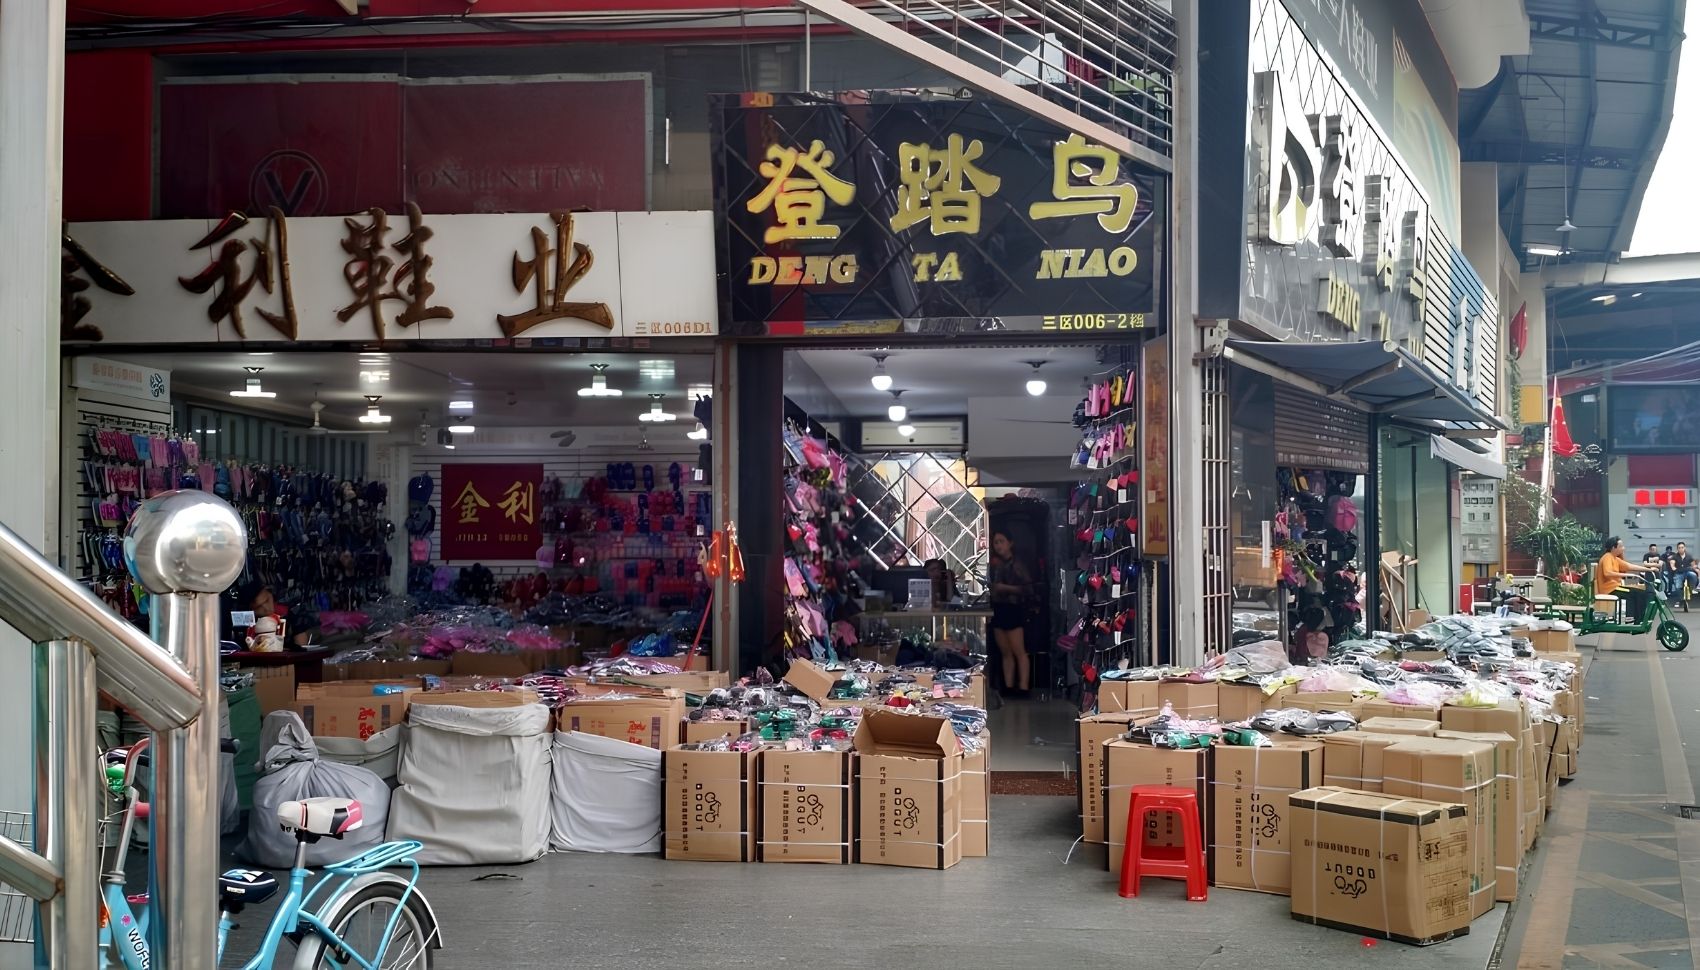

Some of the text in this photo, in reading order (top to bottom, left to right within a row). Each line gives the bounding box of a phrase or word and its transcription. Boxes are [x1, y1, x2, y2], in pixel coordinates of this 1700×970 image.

[747, 133, 1138, 244] 登踏鸟
[748, 246, 1138, 286] DENG TA NIAO
[450, 479, 534, 525] 金利
[796, 785, 806, 834] BOGUT
